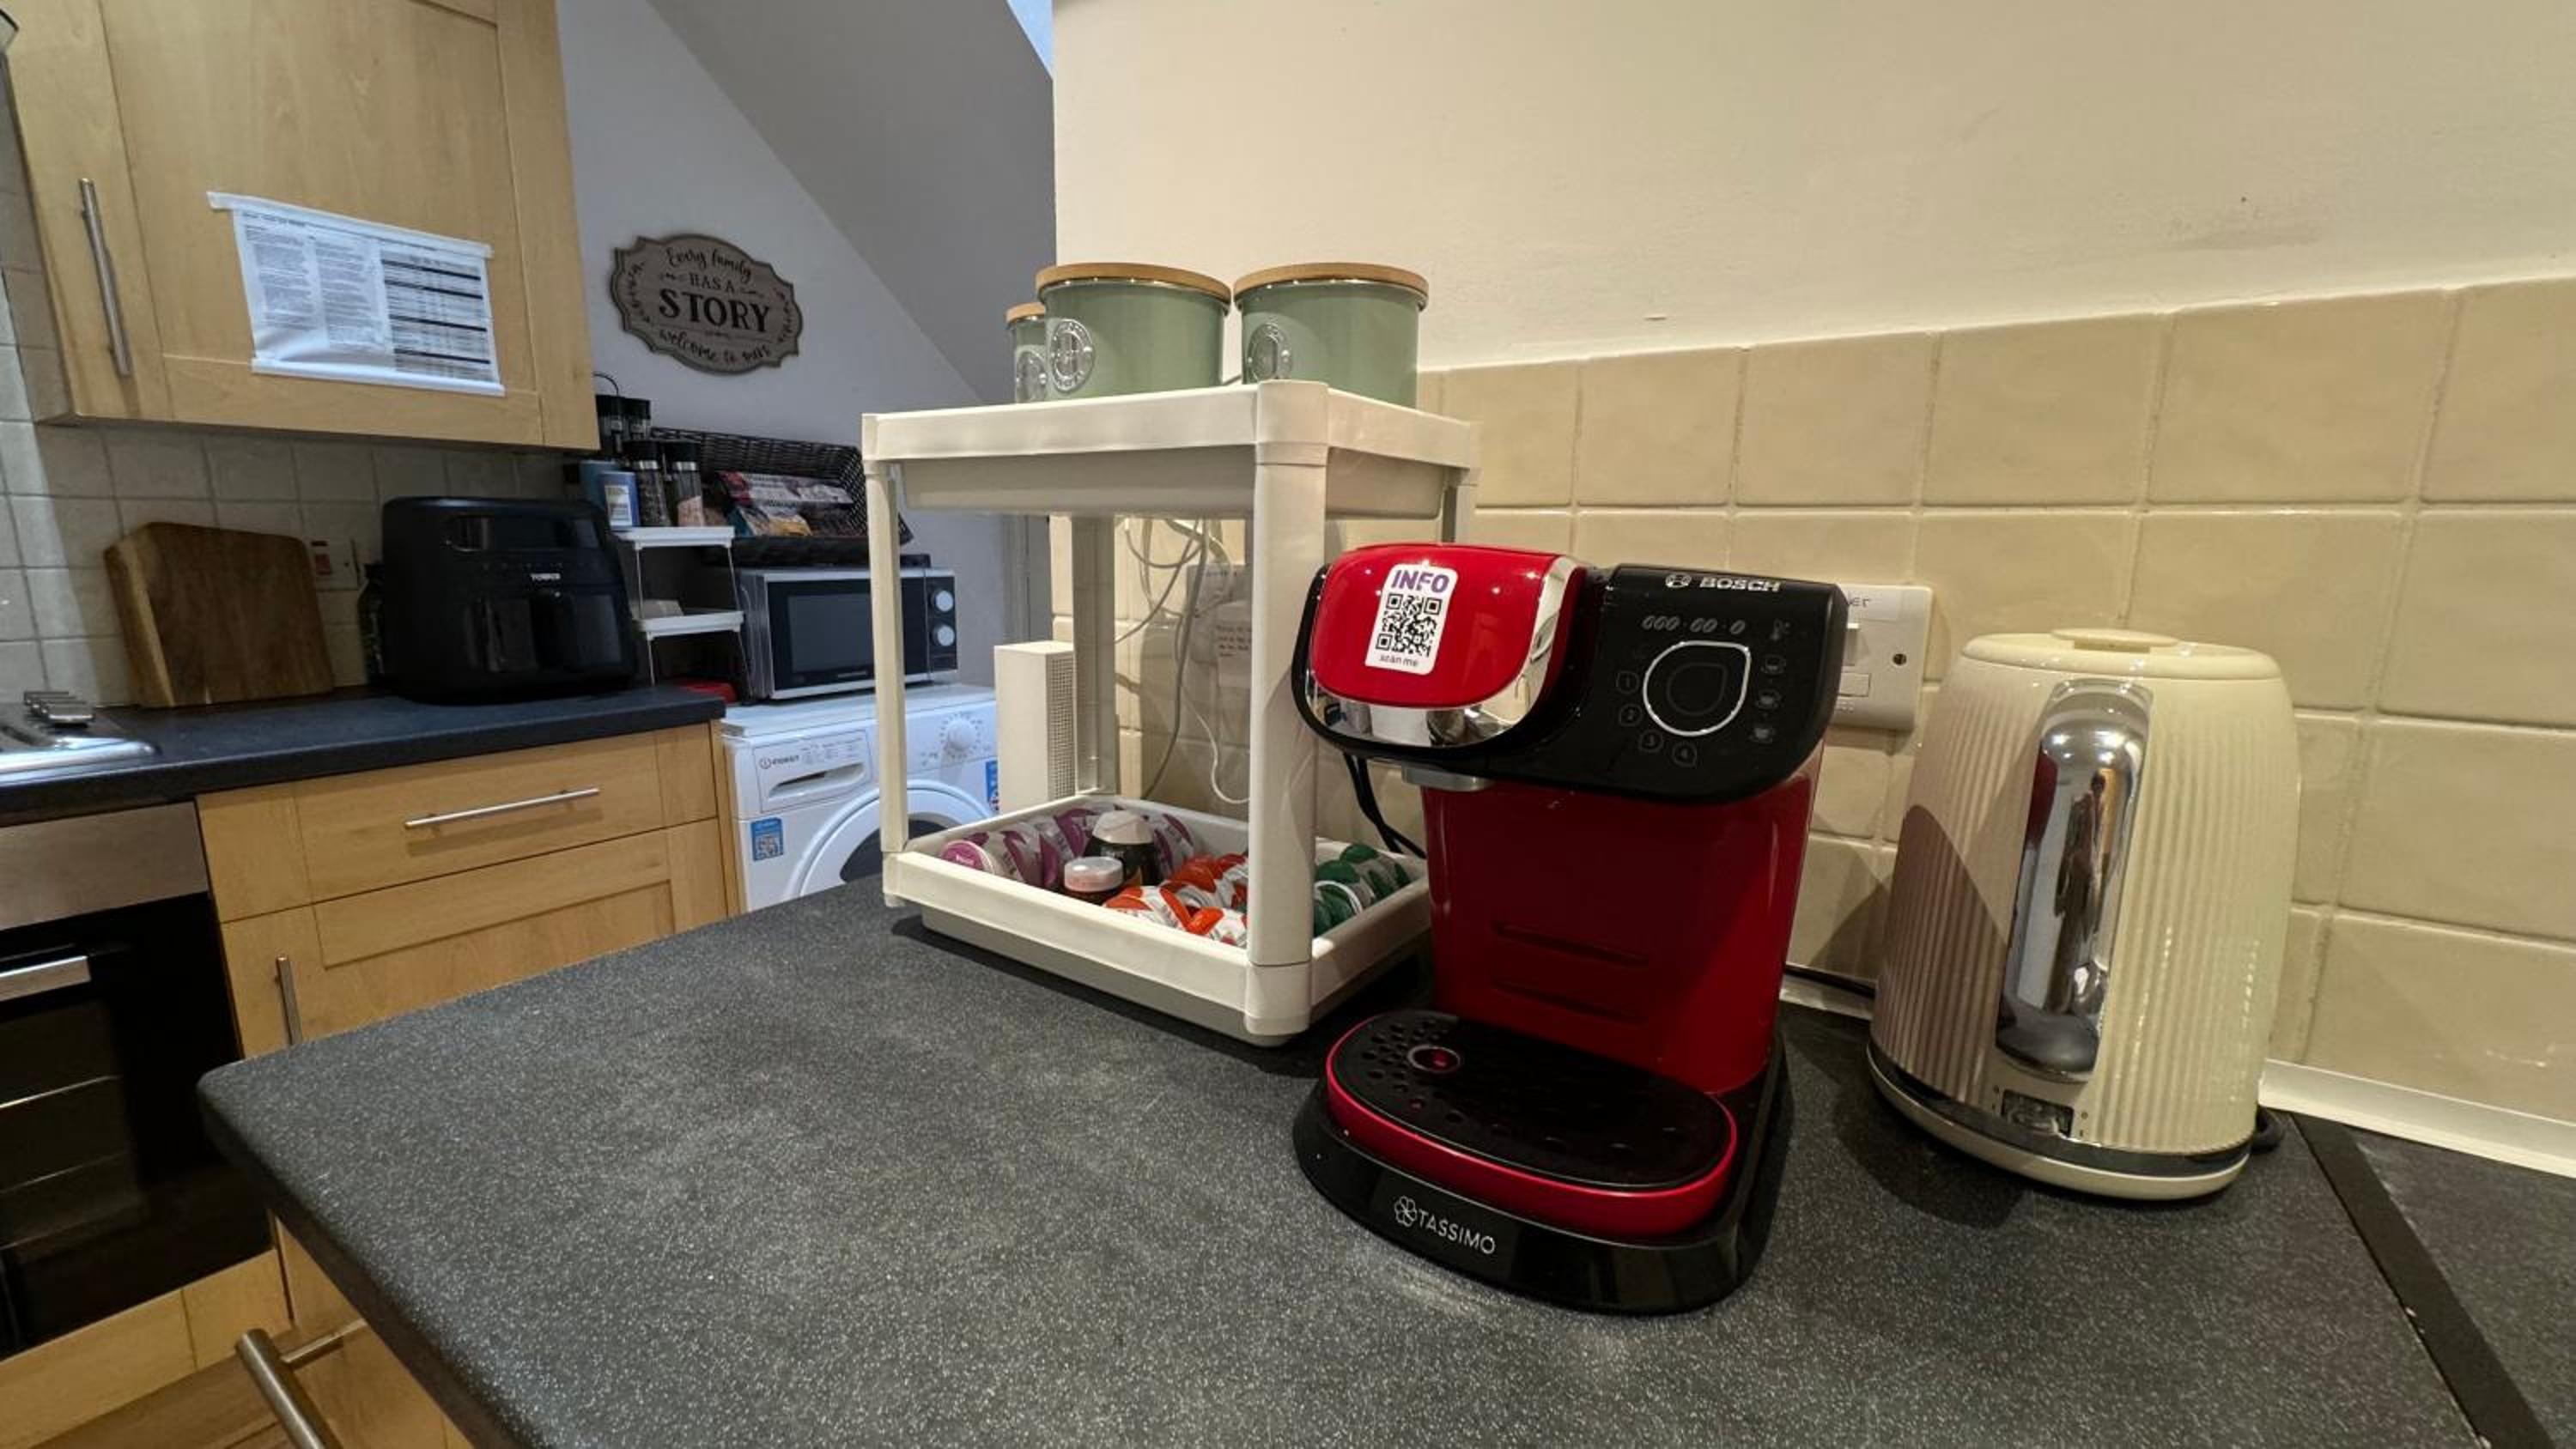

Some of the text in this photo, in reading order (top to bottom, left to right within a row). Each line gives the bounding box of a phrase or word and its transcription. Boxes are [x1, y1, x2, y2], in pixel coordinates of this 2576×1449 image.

[689, 273, 735, 294] HAS A
[659, 288, 770, 332] STORY
[1390, 569, 1449, 593] INFO
[1699, 576, 1783, 593] BOSCH
[1378, 654, 1419, 667] scan me
[1418, 1208, 1497, 1256] TASSIMO
